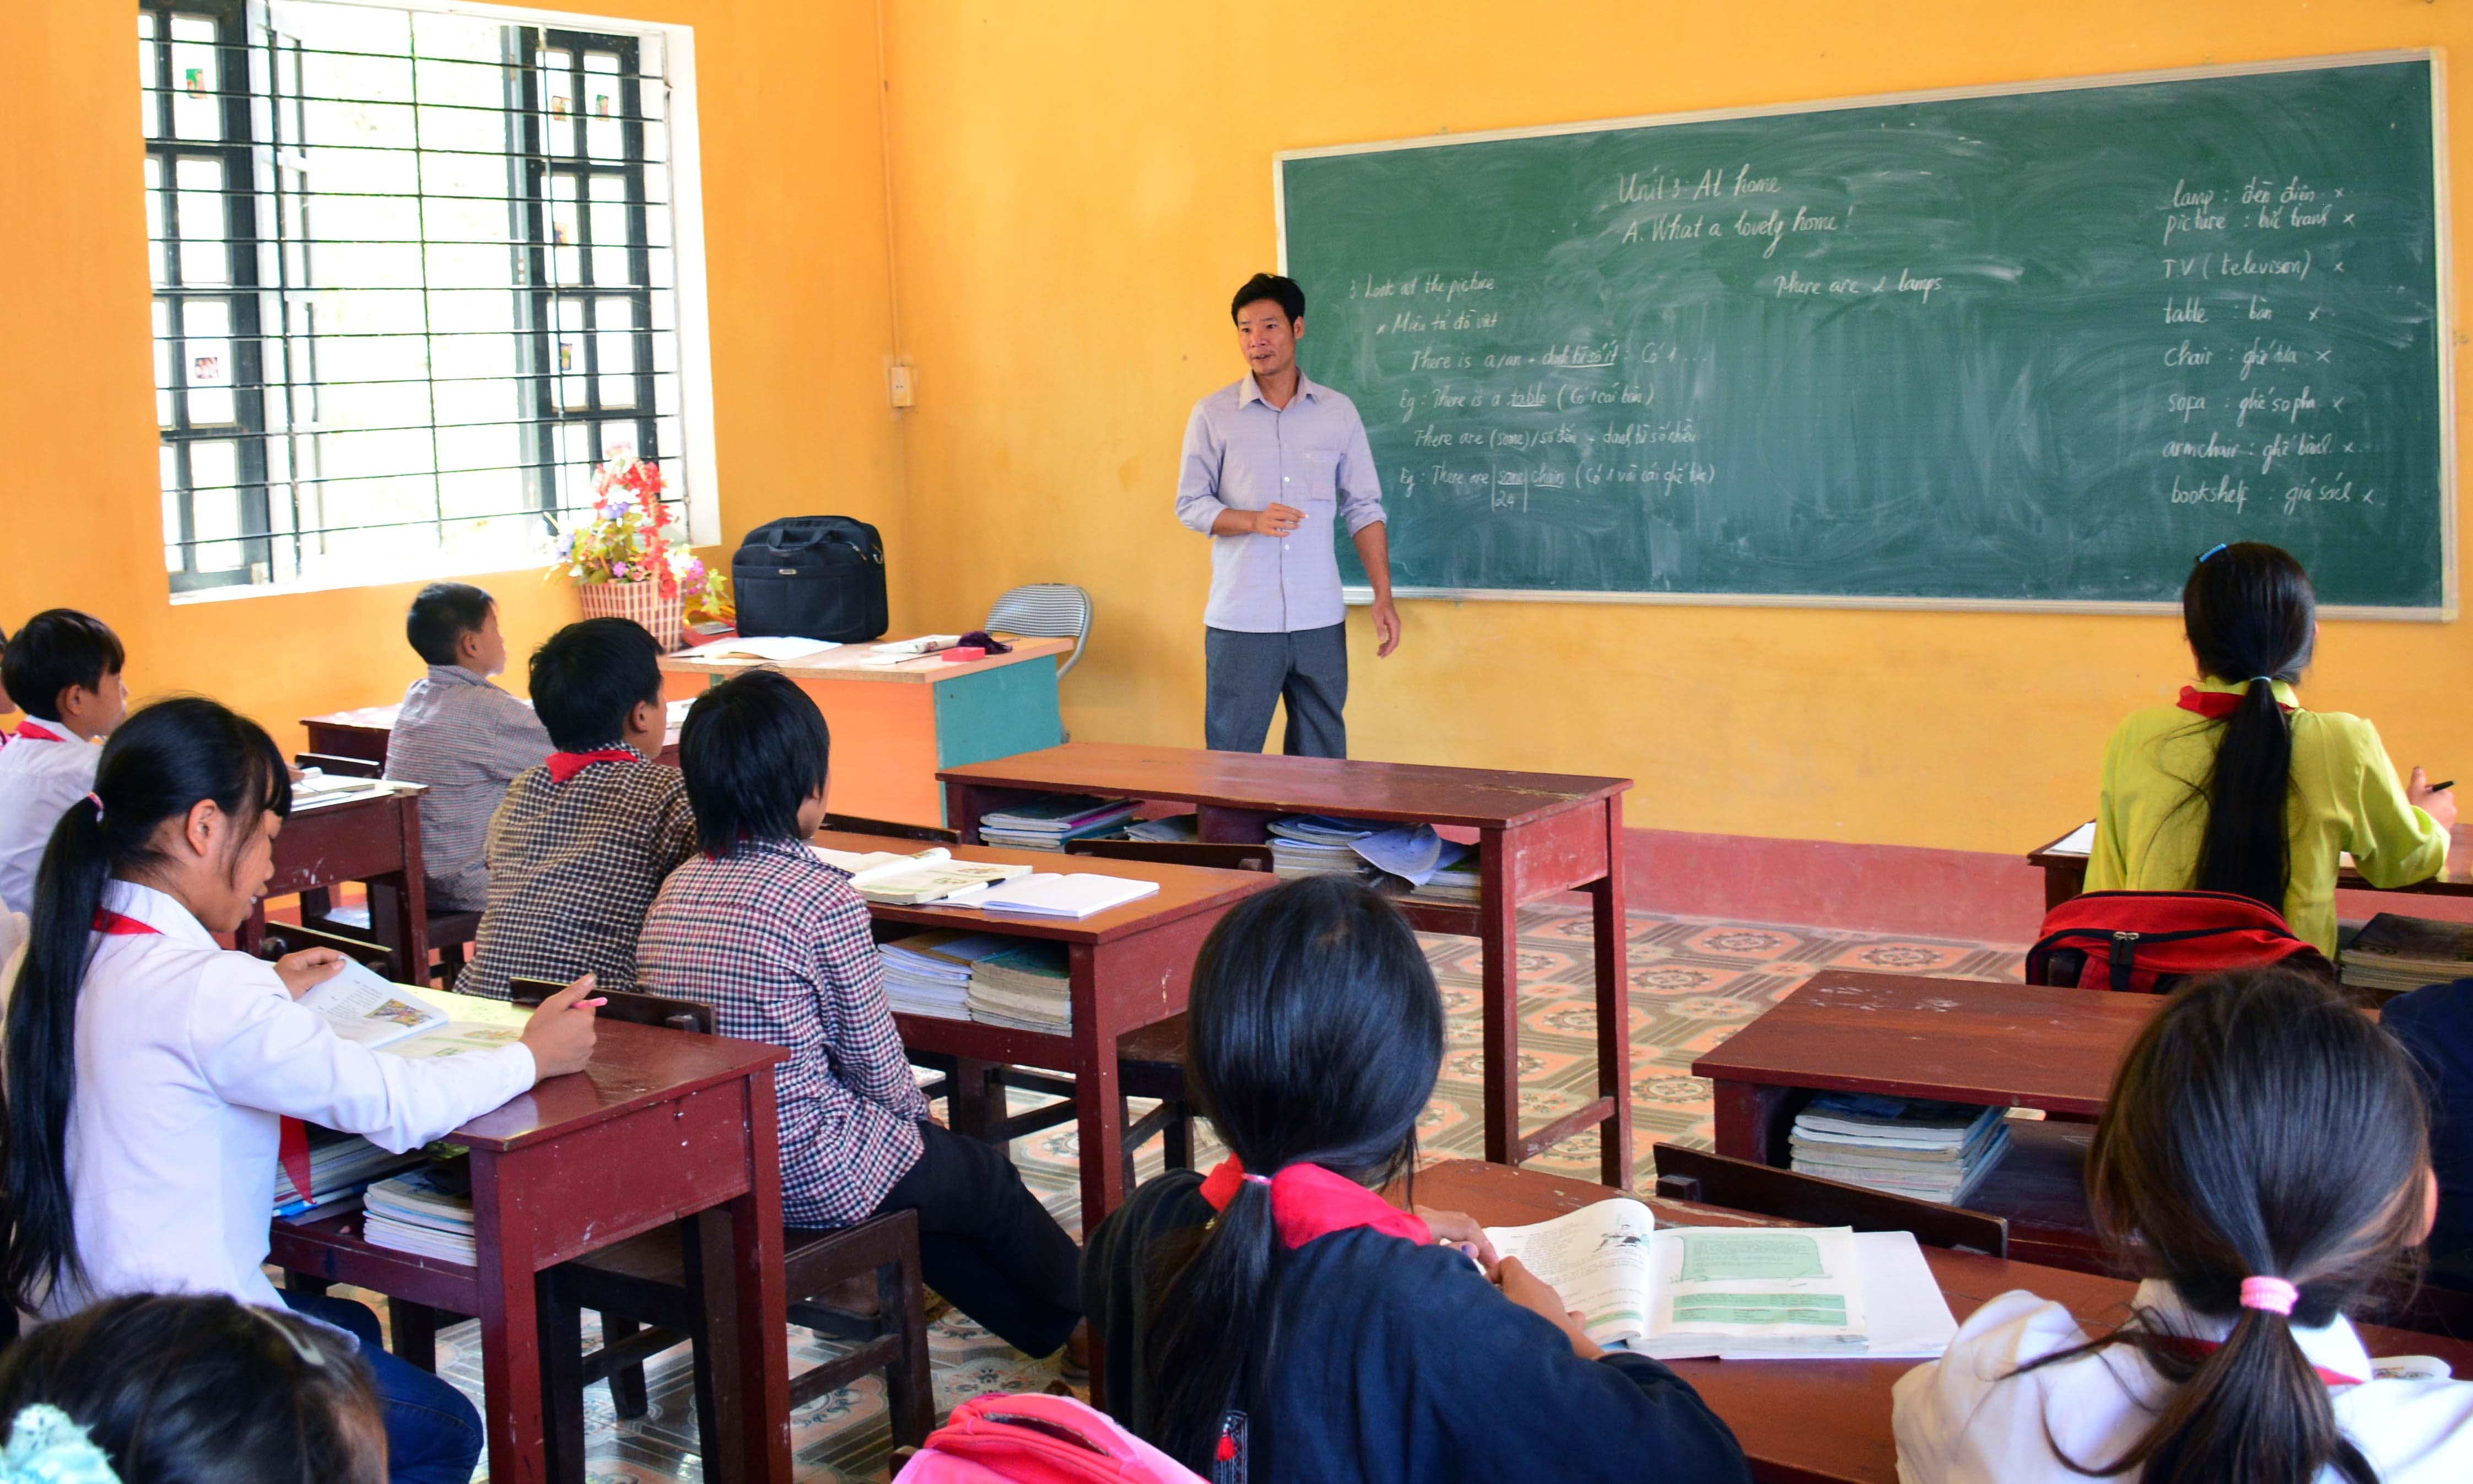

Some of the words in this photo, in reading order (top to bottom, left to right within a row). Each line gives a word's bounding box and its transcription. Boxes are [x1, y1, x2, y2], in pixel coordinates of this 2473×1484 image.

[1618, 167, 1664, 203] Unit
[1693, 168, 1723, 201] At
[1734, 163, 1781, 196] home
[1652, 213, 1704, 241] What
[1709, 223, 1723, 238] a
[1735, 208, 1784, 259] lovely
[2163, 208, 2227, 246] picture
[1365, 273, 1395, 298] Look
[1400, 277, 1418, 295] at
[1424, 273, 1444, 294] the
[1774, 270, 1821, 298] There
[1828, 279, 1860, 294] are
[1898, 267, 1943, 304] lamps
[2163, 296, 2209, 324] table
[1411, 346, 1451, 372] There
[1458, 352, 1471, 368] is
[1432, 385, 1466, 408] There
[1471, 386, 1483, 407] is
[1491, 393, 1501, 407] a
[1414, 423, 1453, 447] There
[1459, 432, 1484, 445] are
[1432, 461, 1463, 485] There
[1469, 472, 1491, 485] are
